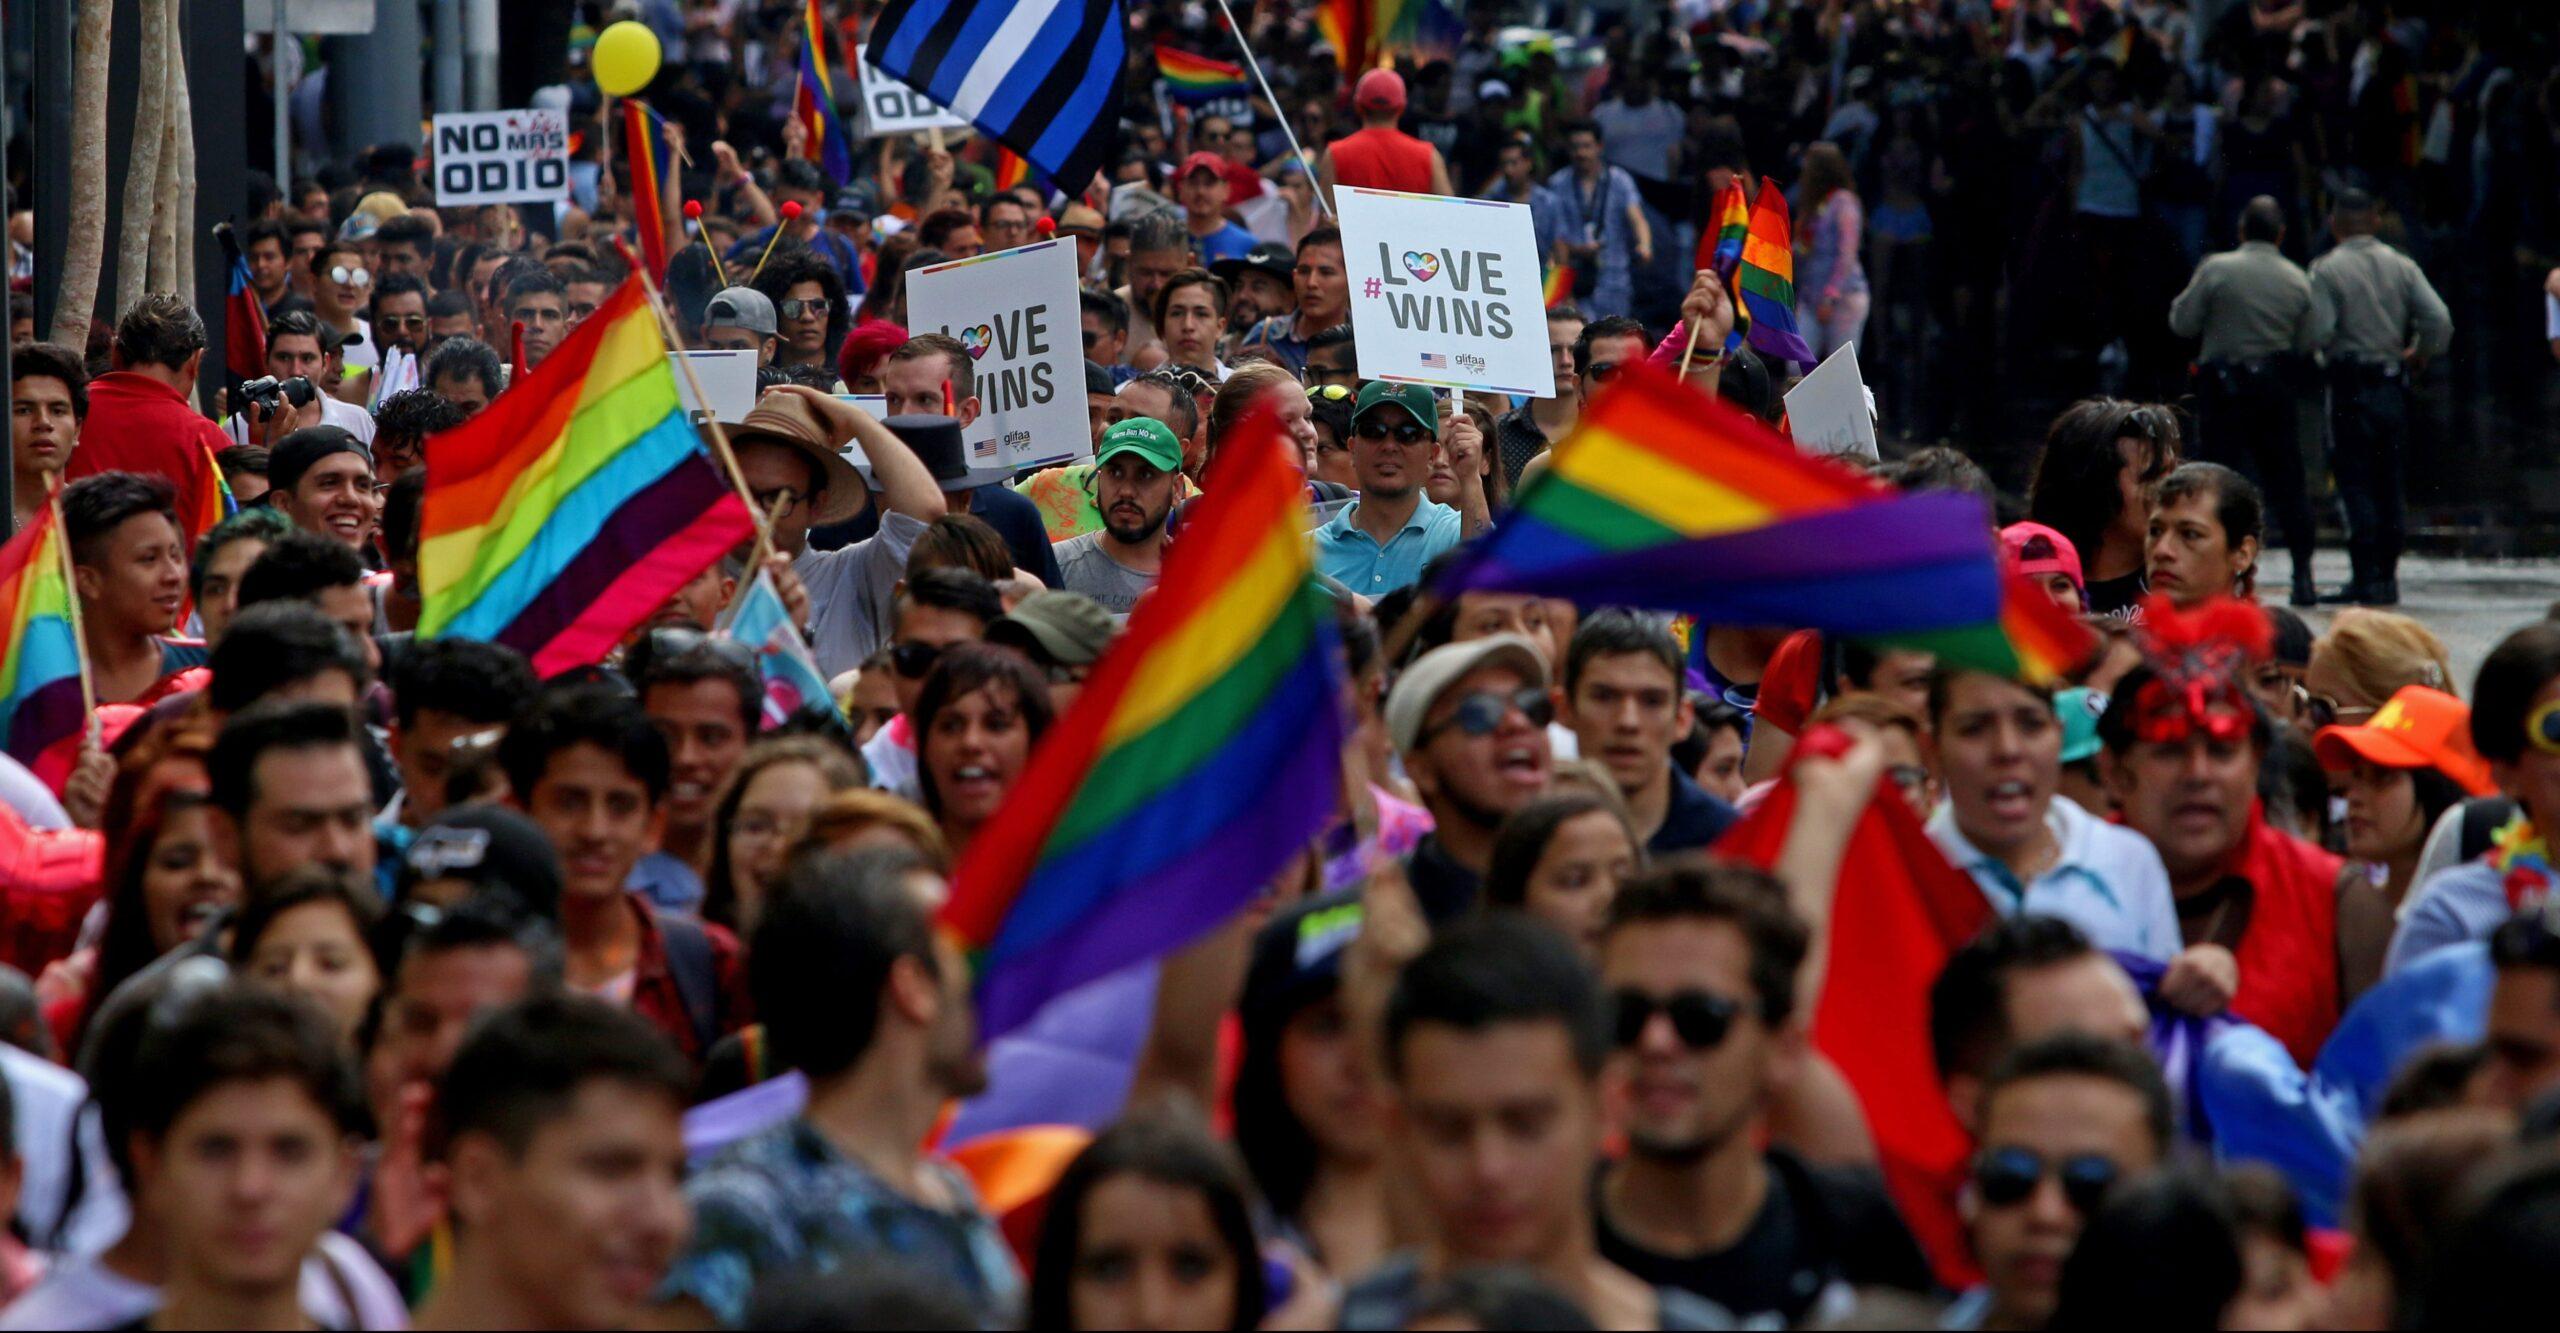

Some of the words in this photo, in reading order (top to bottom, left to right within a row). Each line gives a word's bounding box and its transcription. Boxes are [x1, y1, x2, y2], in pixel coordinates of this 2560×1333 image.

[874, 89, 938, 117] OD
[440, 124, 500, 155] NO
[442, 159, 565, 194] ODIO
[1379, 242, 1506, 295] LOVE
[1386, 292, 1513, 339] WINS
[941, 304, 1049, 361] OVE
[1455, 353, 1485, 365] glifaa
[1004, 430, 1030, 446] glifaa
